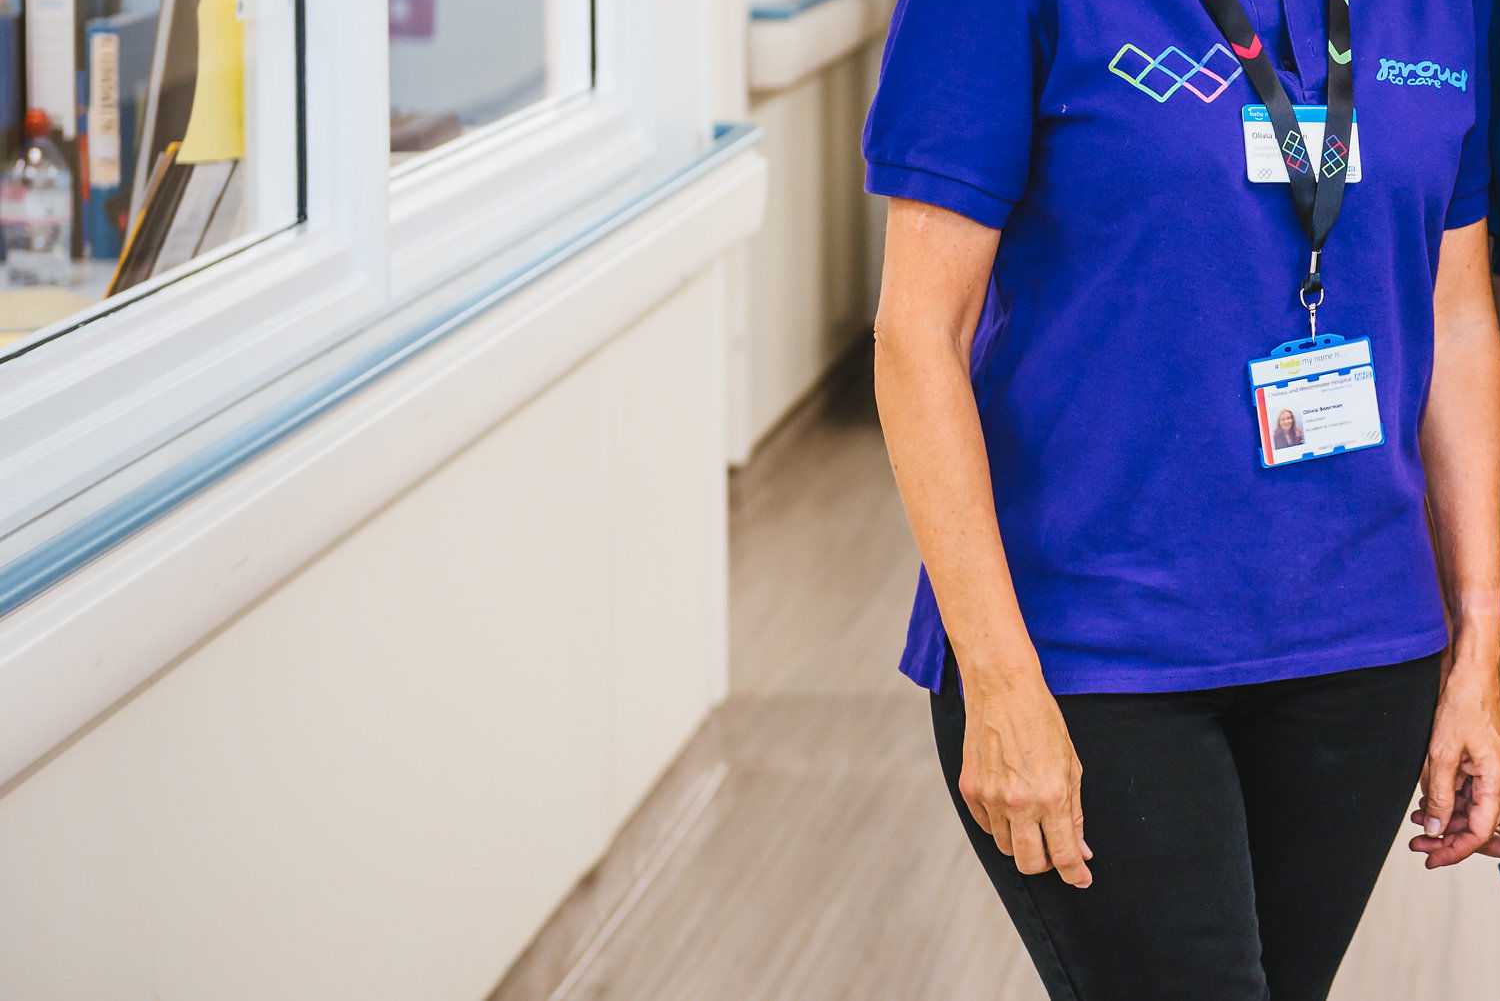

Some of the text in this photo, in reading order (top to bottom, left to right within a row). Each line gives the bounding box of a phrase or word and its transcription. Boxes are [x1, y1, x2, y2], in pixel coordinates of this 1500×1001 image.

[1376, 58, 1468, 92] proud
[1390, 70, 1441, 89] to care
